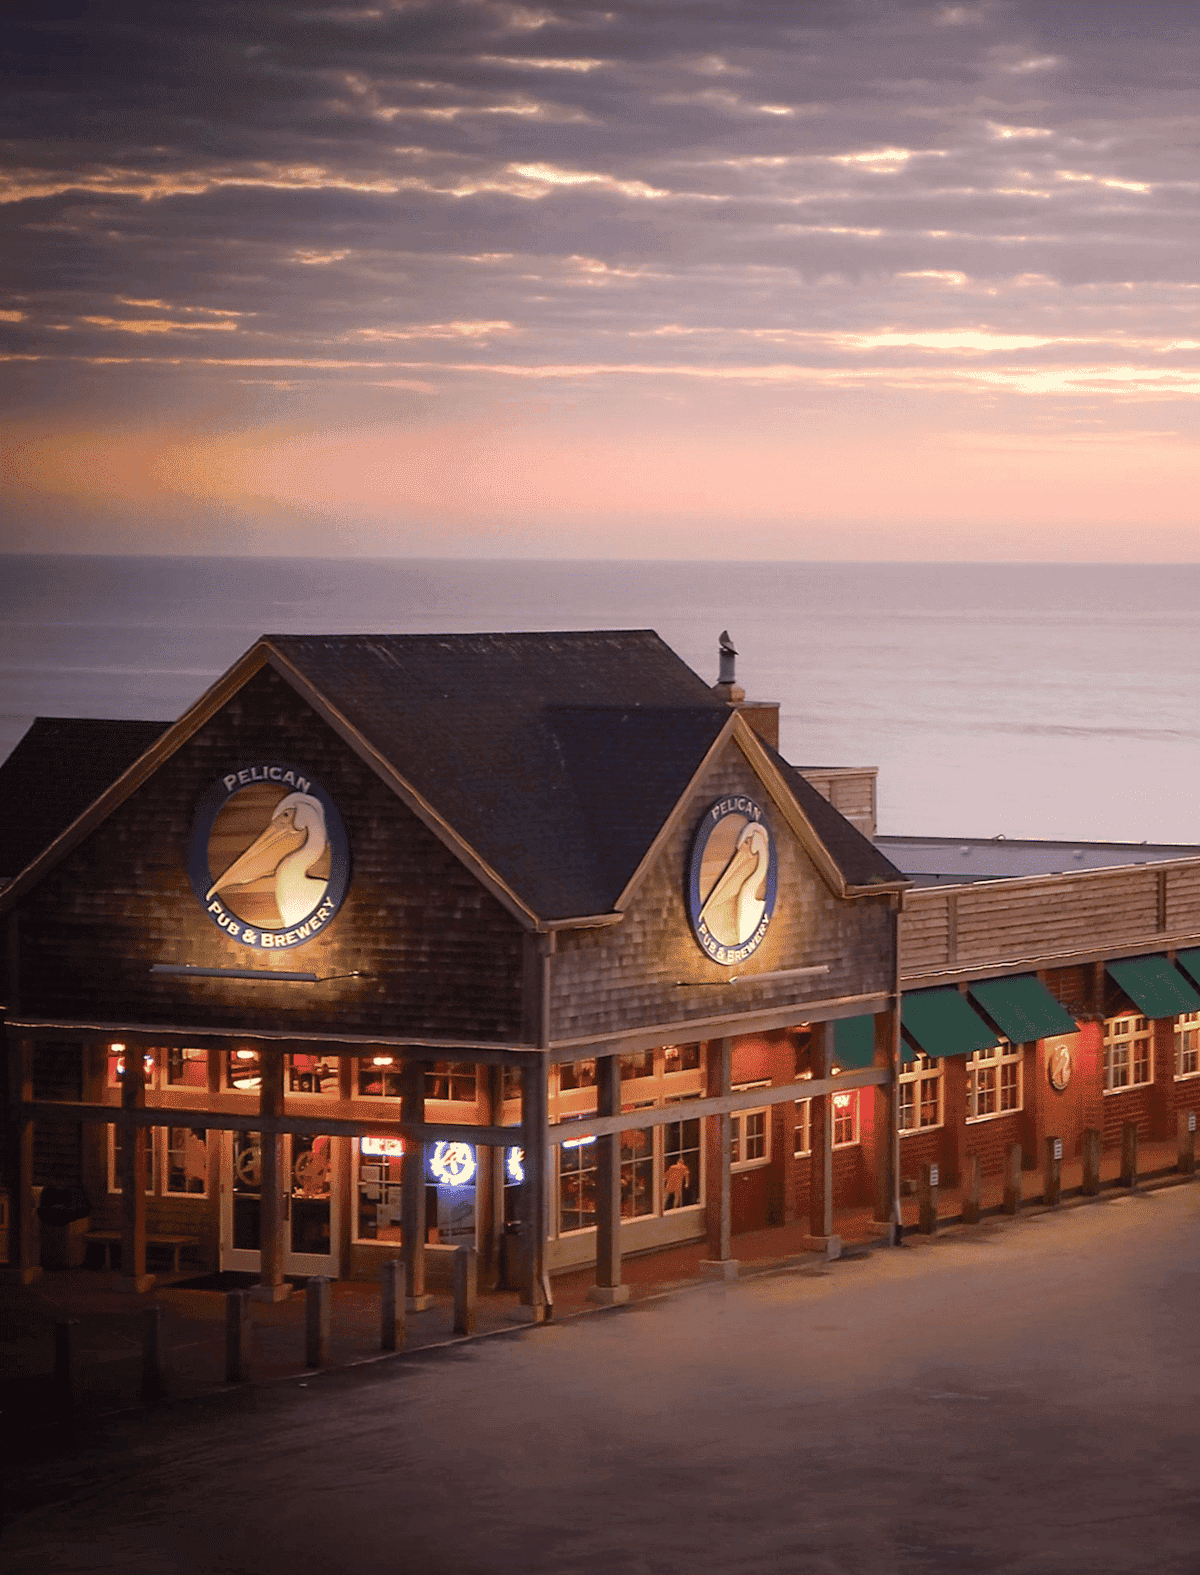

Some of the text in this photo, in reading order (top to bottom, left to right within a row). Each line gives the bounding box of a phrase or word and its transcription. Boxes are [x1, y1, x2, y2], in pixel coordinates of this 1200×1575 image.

[223, 766, 311, 793] PELICAN
[711, 799, 762, 821] PELICAN
[207, 896, 335, 948] PUB & BREWERY
[698, 913, 770, 963] PUB & BREWERY
